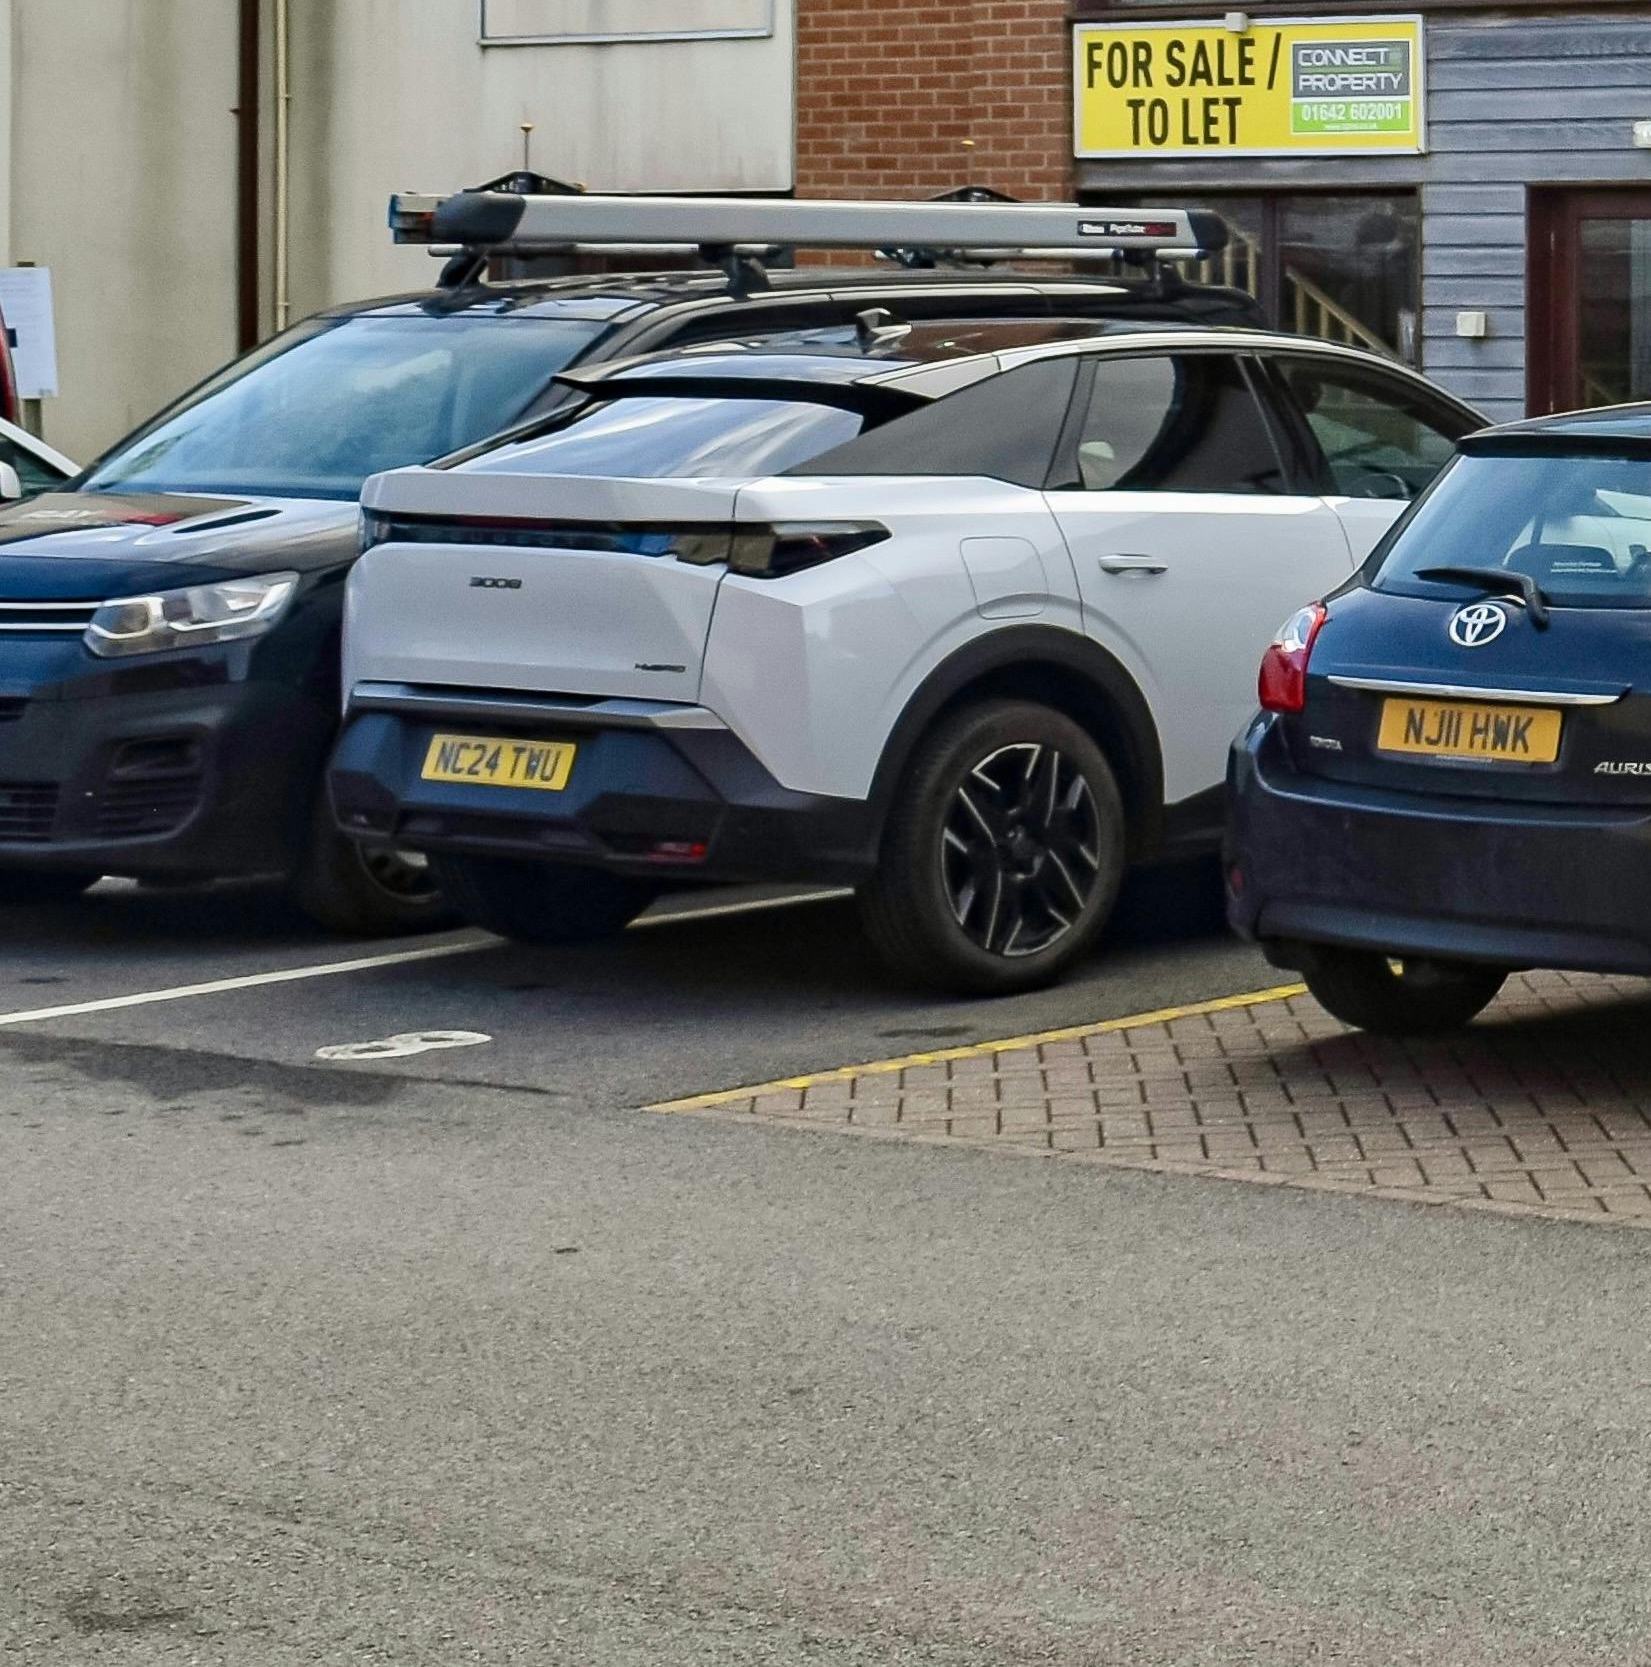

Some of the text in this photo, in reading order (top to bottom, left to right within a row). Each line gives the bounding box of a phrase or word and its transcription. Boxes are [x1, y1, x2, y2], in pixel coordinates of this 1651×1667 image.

[1086, 40, 1153, 89] FOR
[1165, 37, 1256, 88] SALE
[1298, 47, 1389, 66] CONNECT
[1298, 72, 1402, 91] PROPERTY
[1126, 96, 1242, 146] TO LET
[1302, 104, 1346, 121] 01642
[1403, 707, 1536, 754] NJ11 HWK
[434, 742, 562, 782] NC24 TWU
